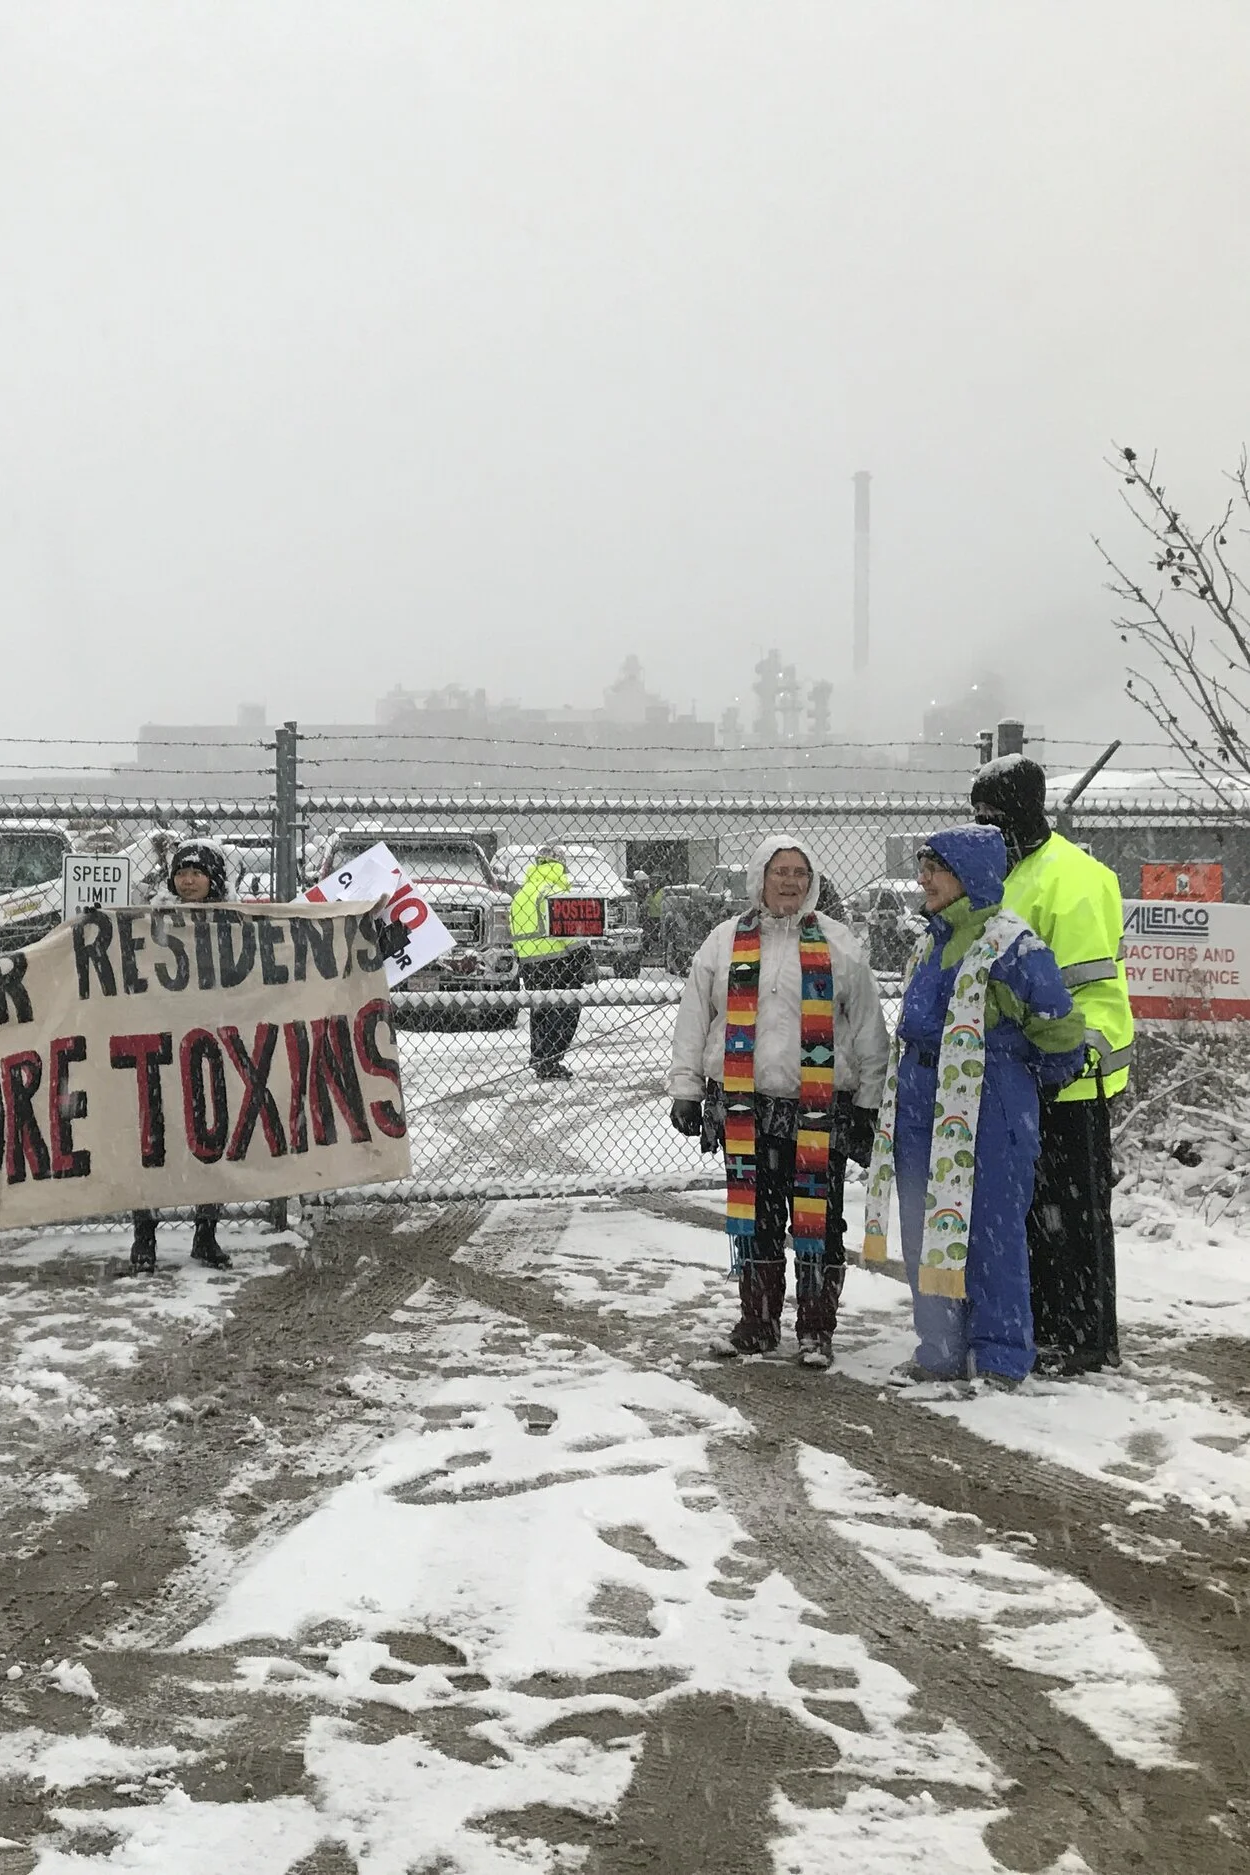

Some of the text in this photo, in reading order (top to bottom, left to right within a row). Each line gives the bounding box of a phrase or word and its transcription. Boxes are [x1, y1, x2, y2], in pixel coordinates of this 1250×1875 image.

[73, 866, 121, 882] SPEED
[78, 886, 117, 903] LIMIT
[553, 900, 601, 919] POSTED
[1203, 948, 1235, 962] AND
[1152, 968, 1240, 985] ENTNCE
[109, 998, 407, 1168] TOXINS
